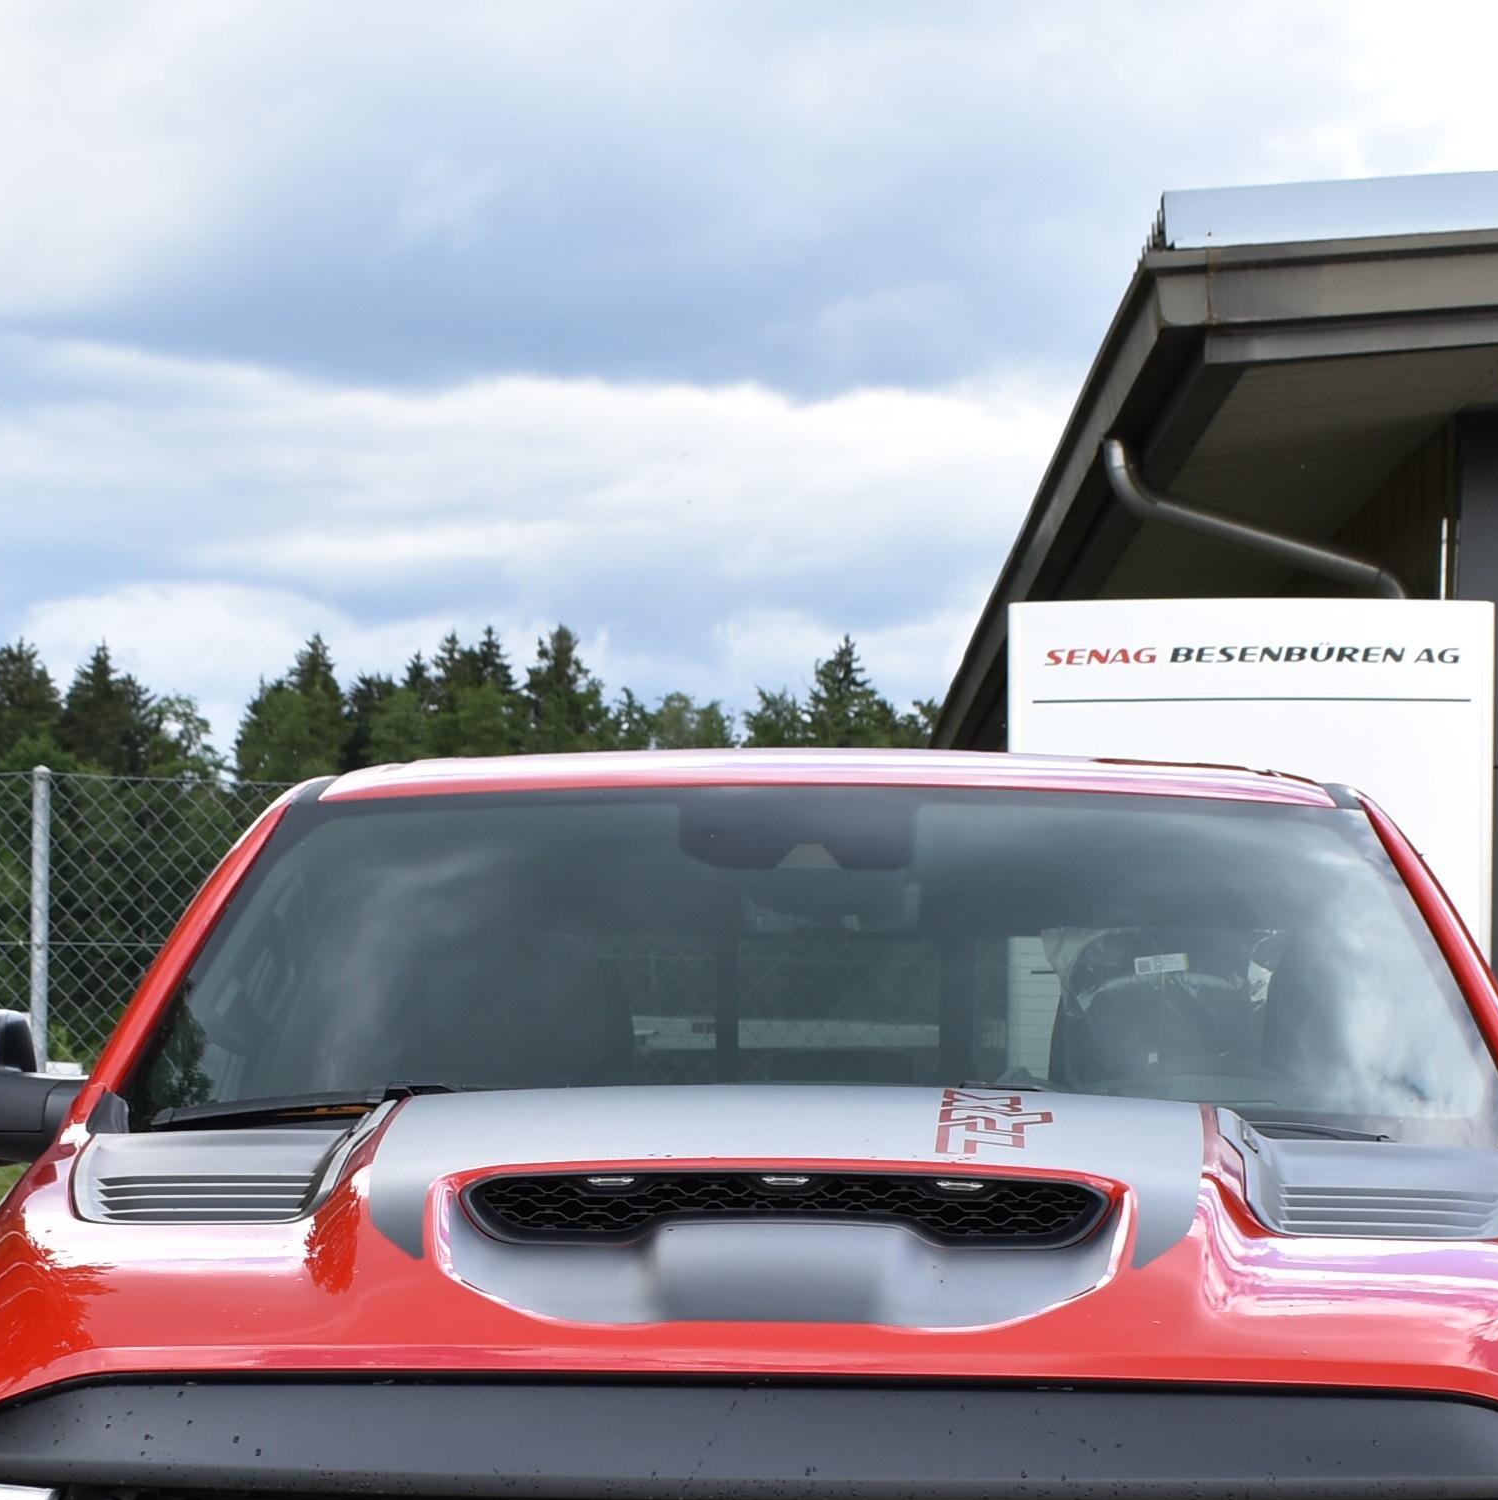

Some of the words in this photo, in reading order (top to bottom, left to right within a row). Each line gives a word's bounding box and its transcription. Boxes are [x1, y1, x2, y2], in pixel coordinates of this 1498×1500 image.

[1043, 646, 1158, 667] SENAG
[1168, 641, 1407, 664] BESENBÜREN
[1413, 646, 1461, 666] AG
